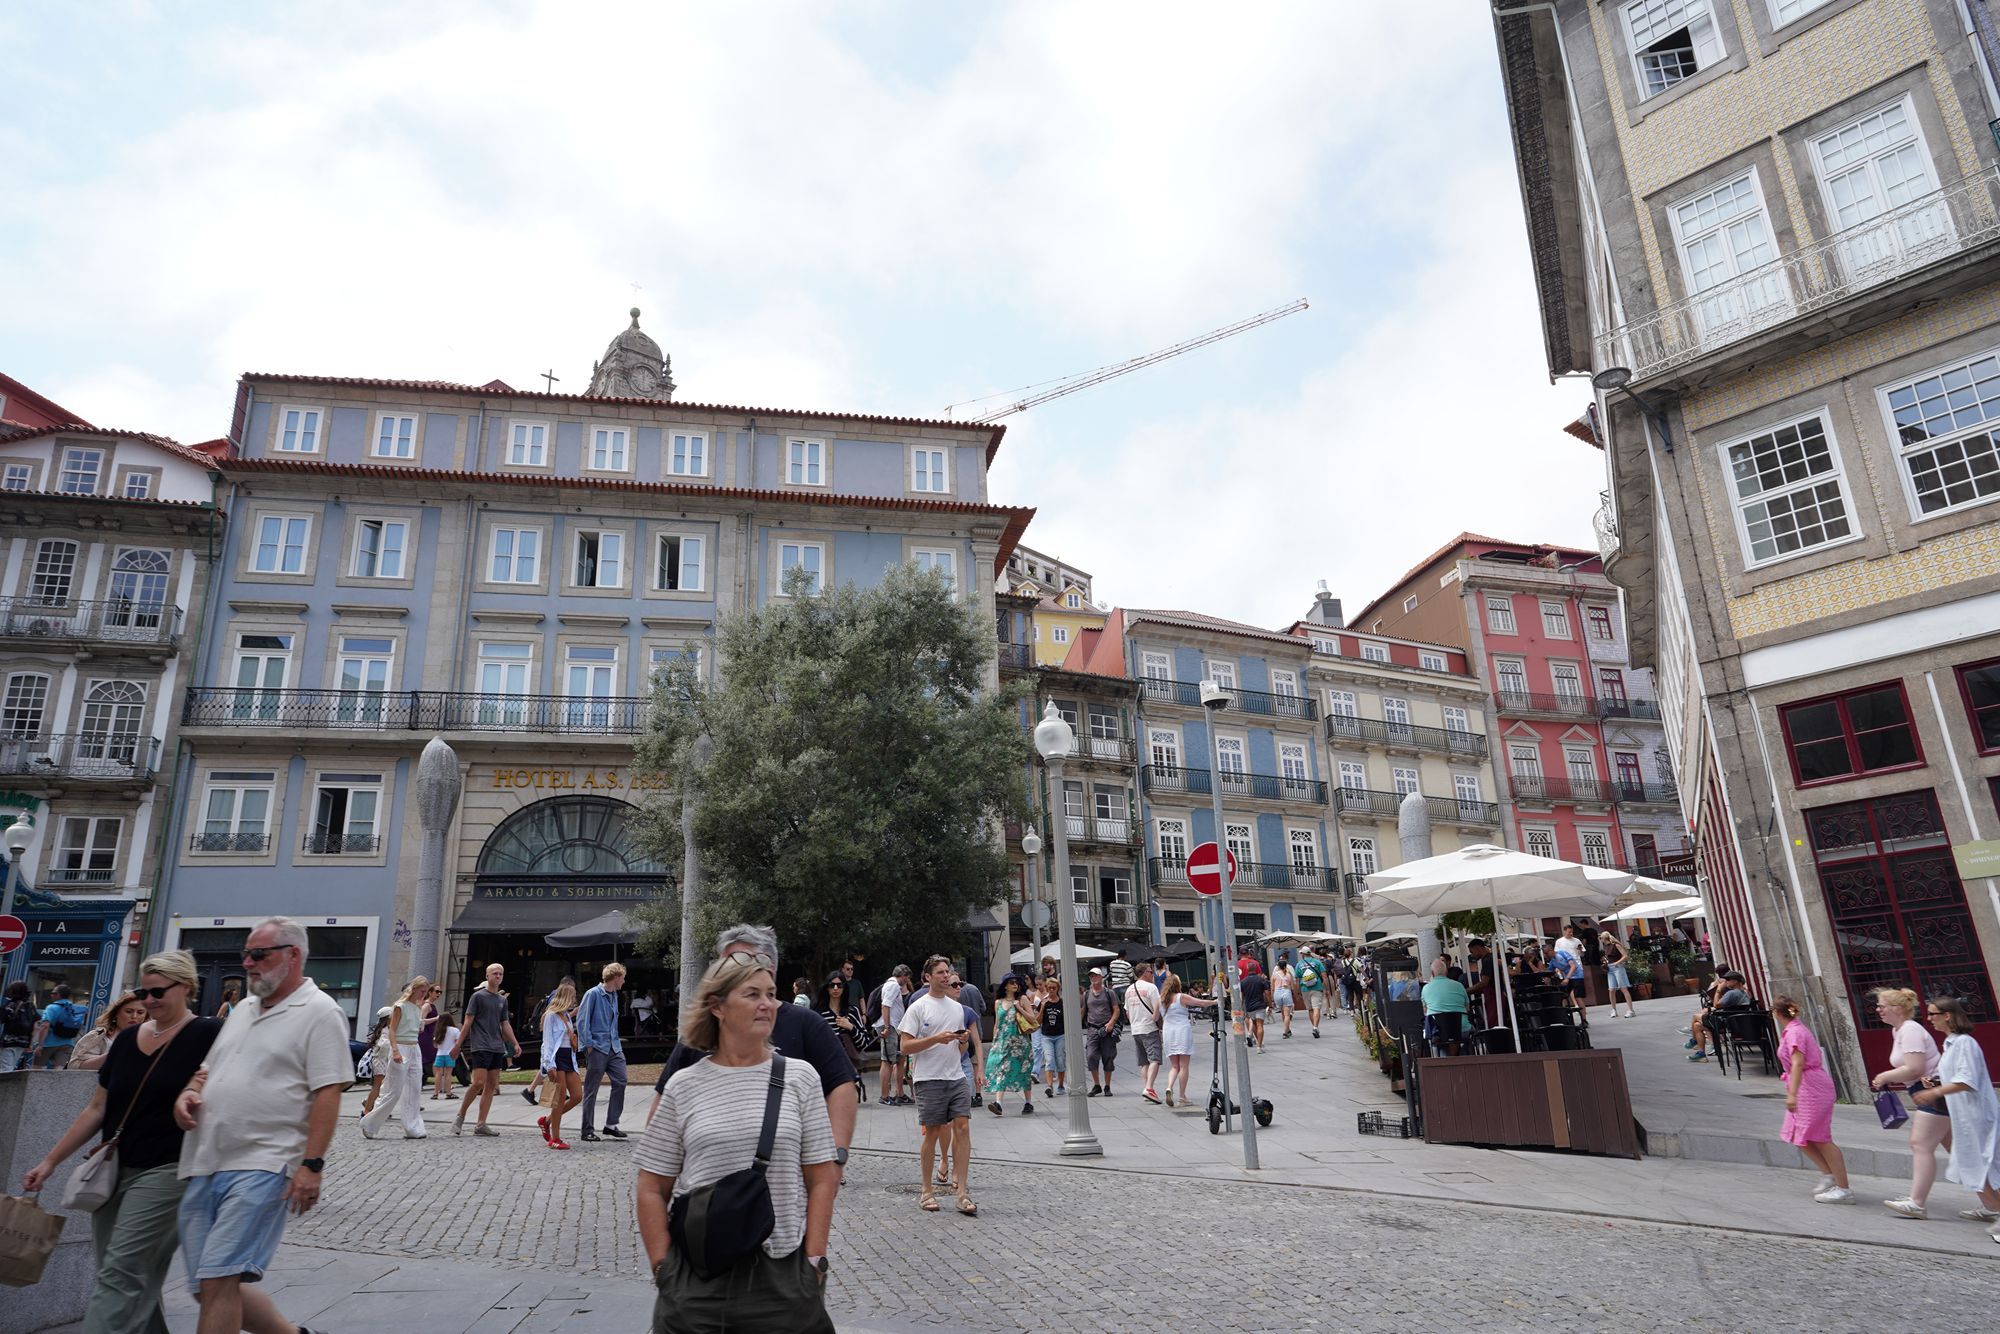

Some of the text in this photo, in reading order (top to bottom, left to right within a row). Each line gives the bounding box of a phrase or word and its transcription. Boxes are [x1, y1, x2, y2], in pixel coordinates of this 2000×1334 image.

[493, 769, 576, 788] HOTEL
[581, 771, 624, 789] A.S.
[484, 886, 544, 897] ARAÚJO
[551, 888, 559, 897] &
[40, 947, 91, 955] APOTHEKE
